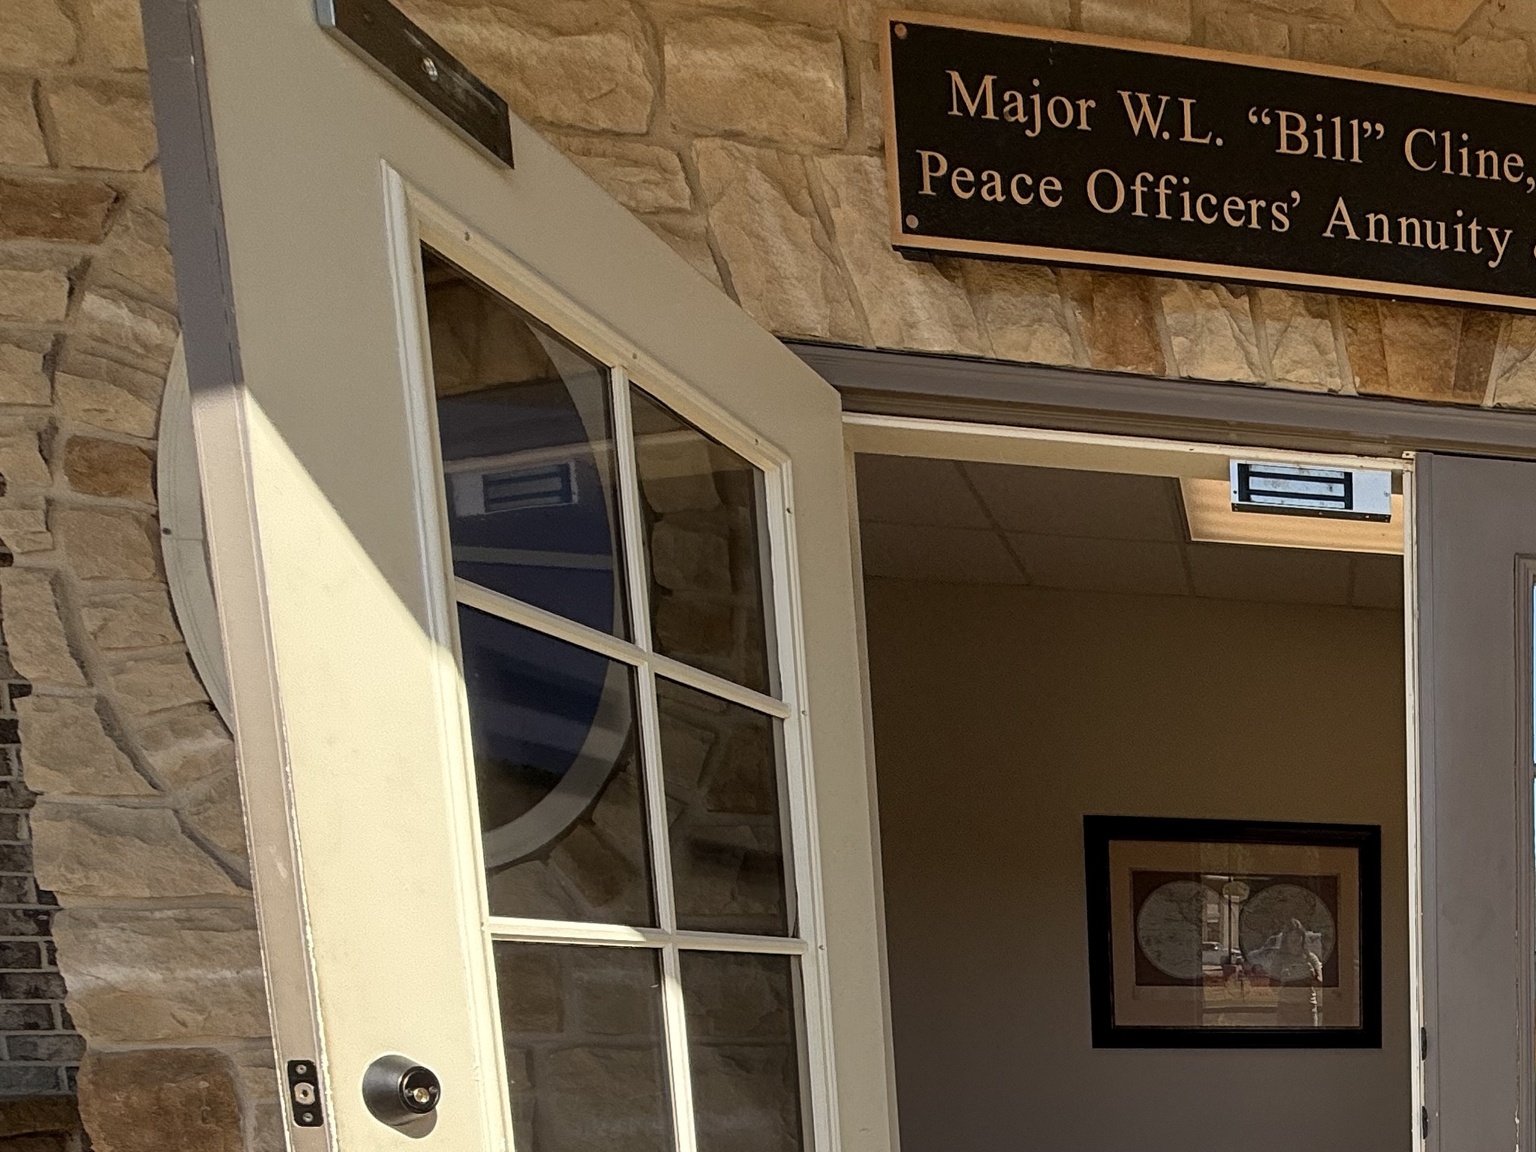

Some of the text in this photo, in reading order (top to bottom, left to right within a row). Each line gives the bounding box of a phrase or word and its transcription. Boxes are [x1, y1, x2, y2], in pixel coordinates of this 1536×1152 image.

[947, 70, 1097, 138] Major
[1118, 91, 1225, 147] W.L.
[1248, 106, 1386, 164] “Bill”
[1404, 128, 1536, 195] Cline,
[915, 149, 1064, 209] Peace
[1322, 196, 1514, 268] Annuity
